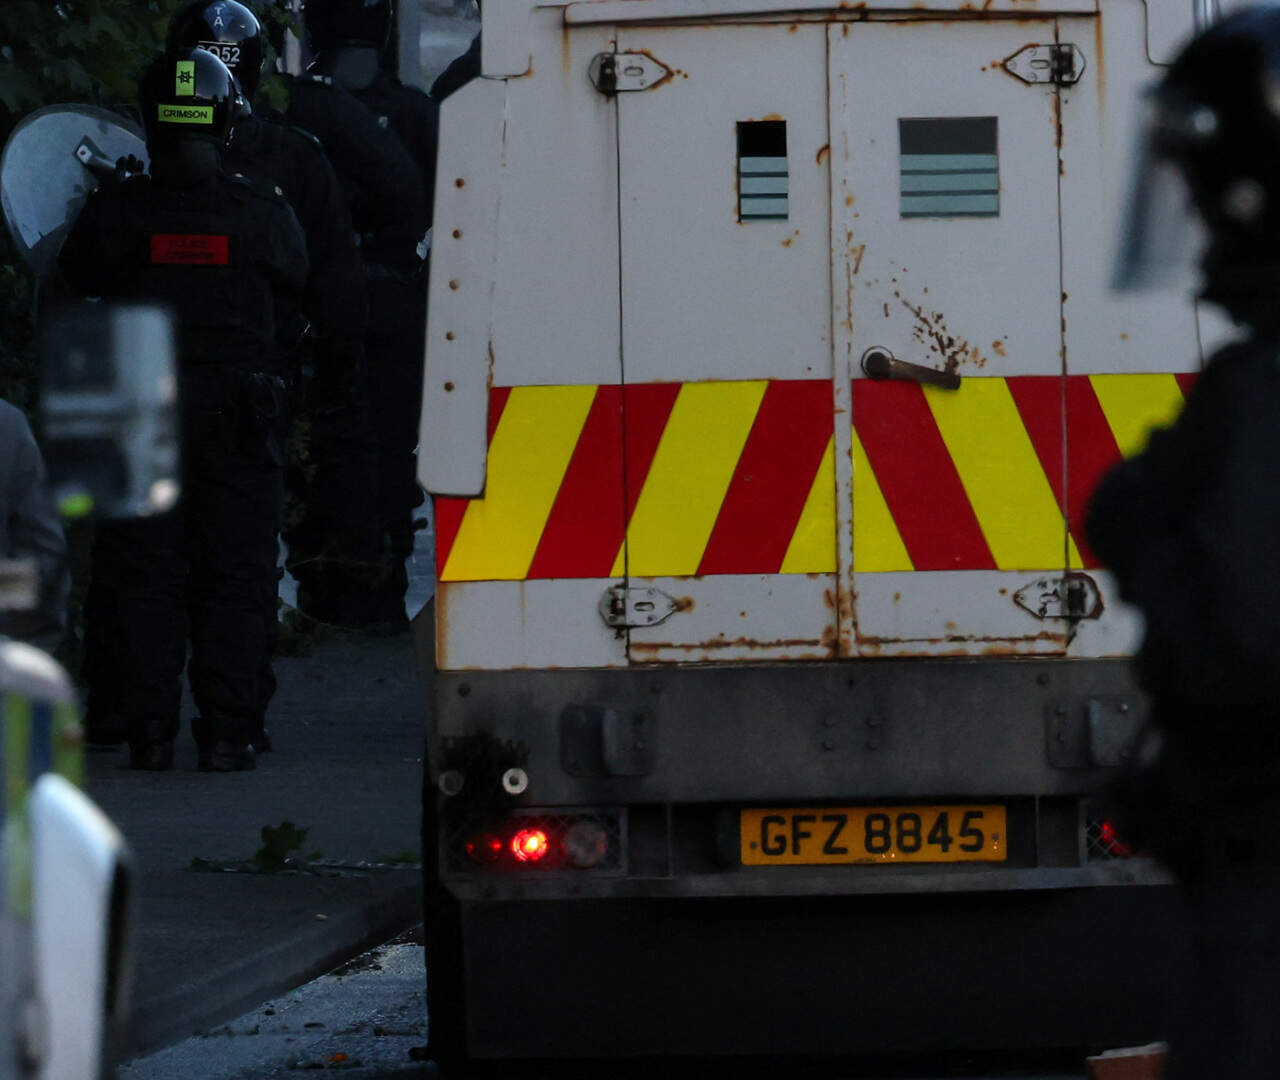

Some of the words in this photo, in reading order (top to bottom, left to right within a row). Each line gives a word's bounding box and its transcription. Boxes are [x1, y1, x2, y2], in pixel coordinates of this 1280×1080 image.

[162, 108, 208, 120] CRIMSON
[760, 813, 849, 856] GFZ
[863, 810, 986, 854] 8845
